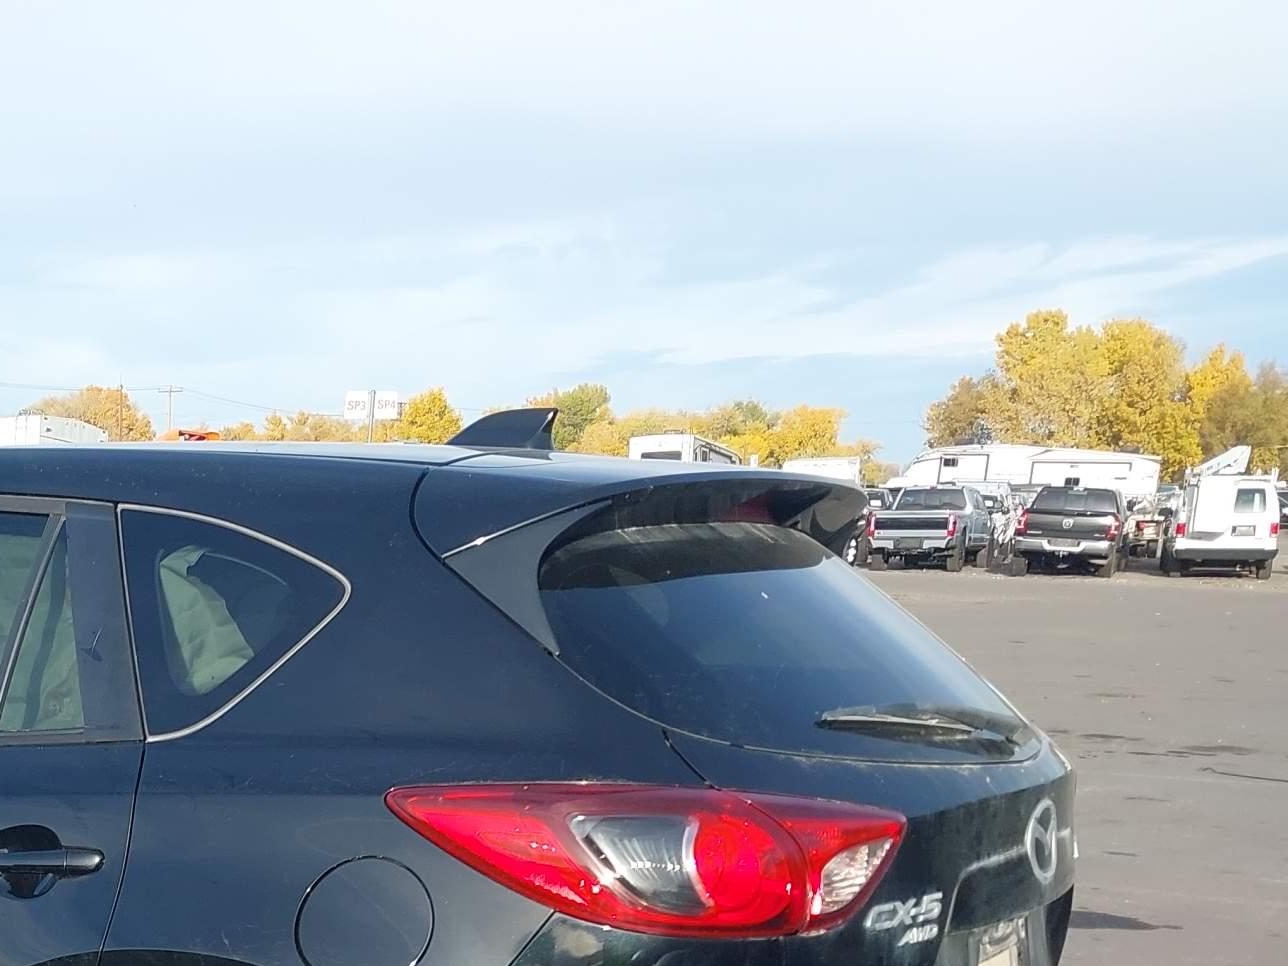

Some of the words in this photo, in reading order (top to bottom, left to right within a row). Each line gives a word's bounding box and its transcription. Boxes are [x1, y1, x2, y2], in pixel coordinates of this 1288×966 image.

[347, 400, 367, 410] SP3
[378, 399, 396, 409] SP4
[863, 891, 944, 931] CX-5
[896, 923, 939, 947] AWD
